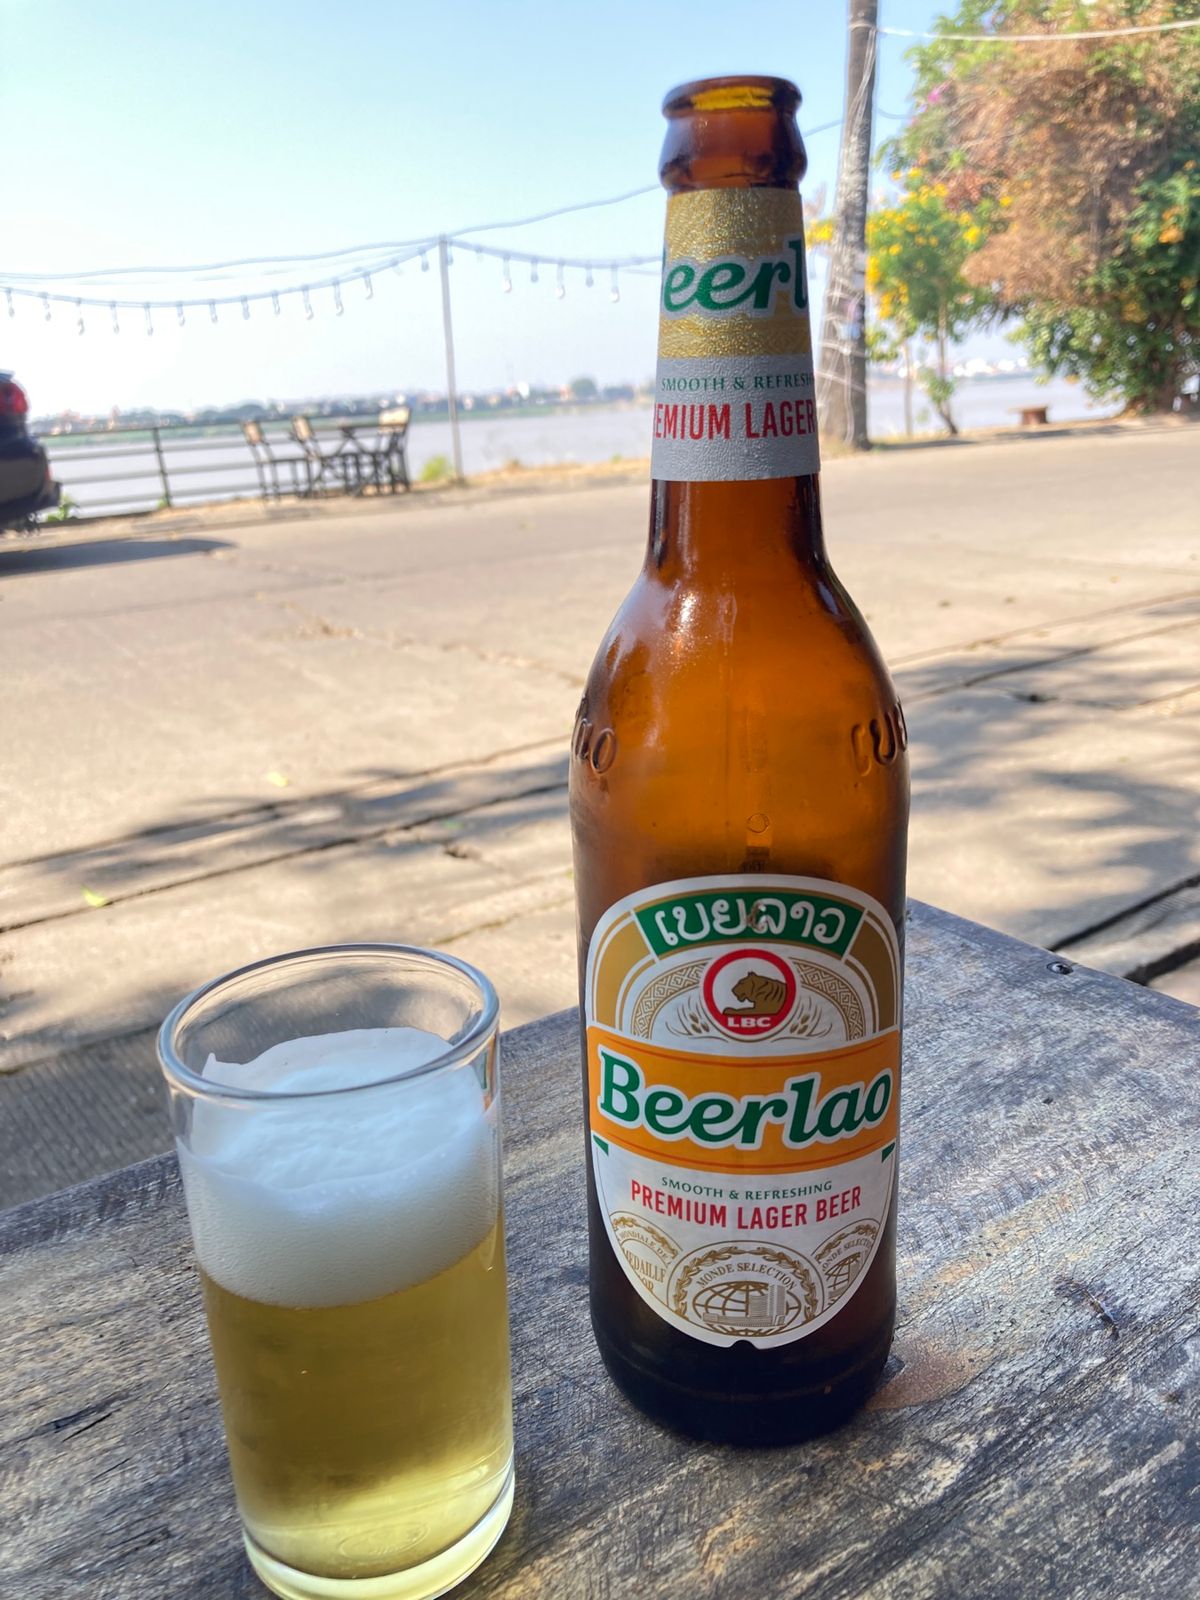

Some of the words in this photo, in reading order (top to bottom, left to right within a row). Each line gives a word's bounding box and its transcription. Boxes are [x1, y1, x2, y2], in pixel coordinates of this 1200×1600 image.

[662, 239, 807, 312] eerl
[661, 377, 724, 391] SMOOTH
[733, 376, 745, 390] &
[654, 403, 731, 440] EMIUM
[745, 400, 815, 438] LAGER
[654, 897, 846, 946] ເບຍລາວ
[727, 1016, 772, 1029] LBC
[599, 1049, 892, 1145] Beerlao
[631, 1179, 727, 1228] PREMIUM
[737, 1203, 807, 1229] LAGER
[816, 1185, 861, 1222] BEER
[661, 1177, 723, 1198] SMOOTH
[729, 1190, 739, 1200] &
[745, 1181, 832, 1200] REFRESHING
[697, 1263, 734, 1288] MONDE
[737, 1262, 797, 1290] SELECTION
